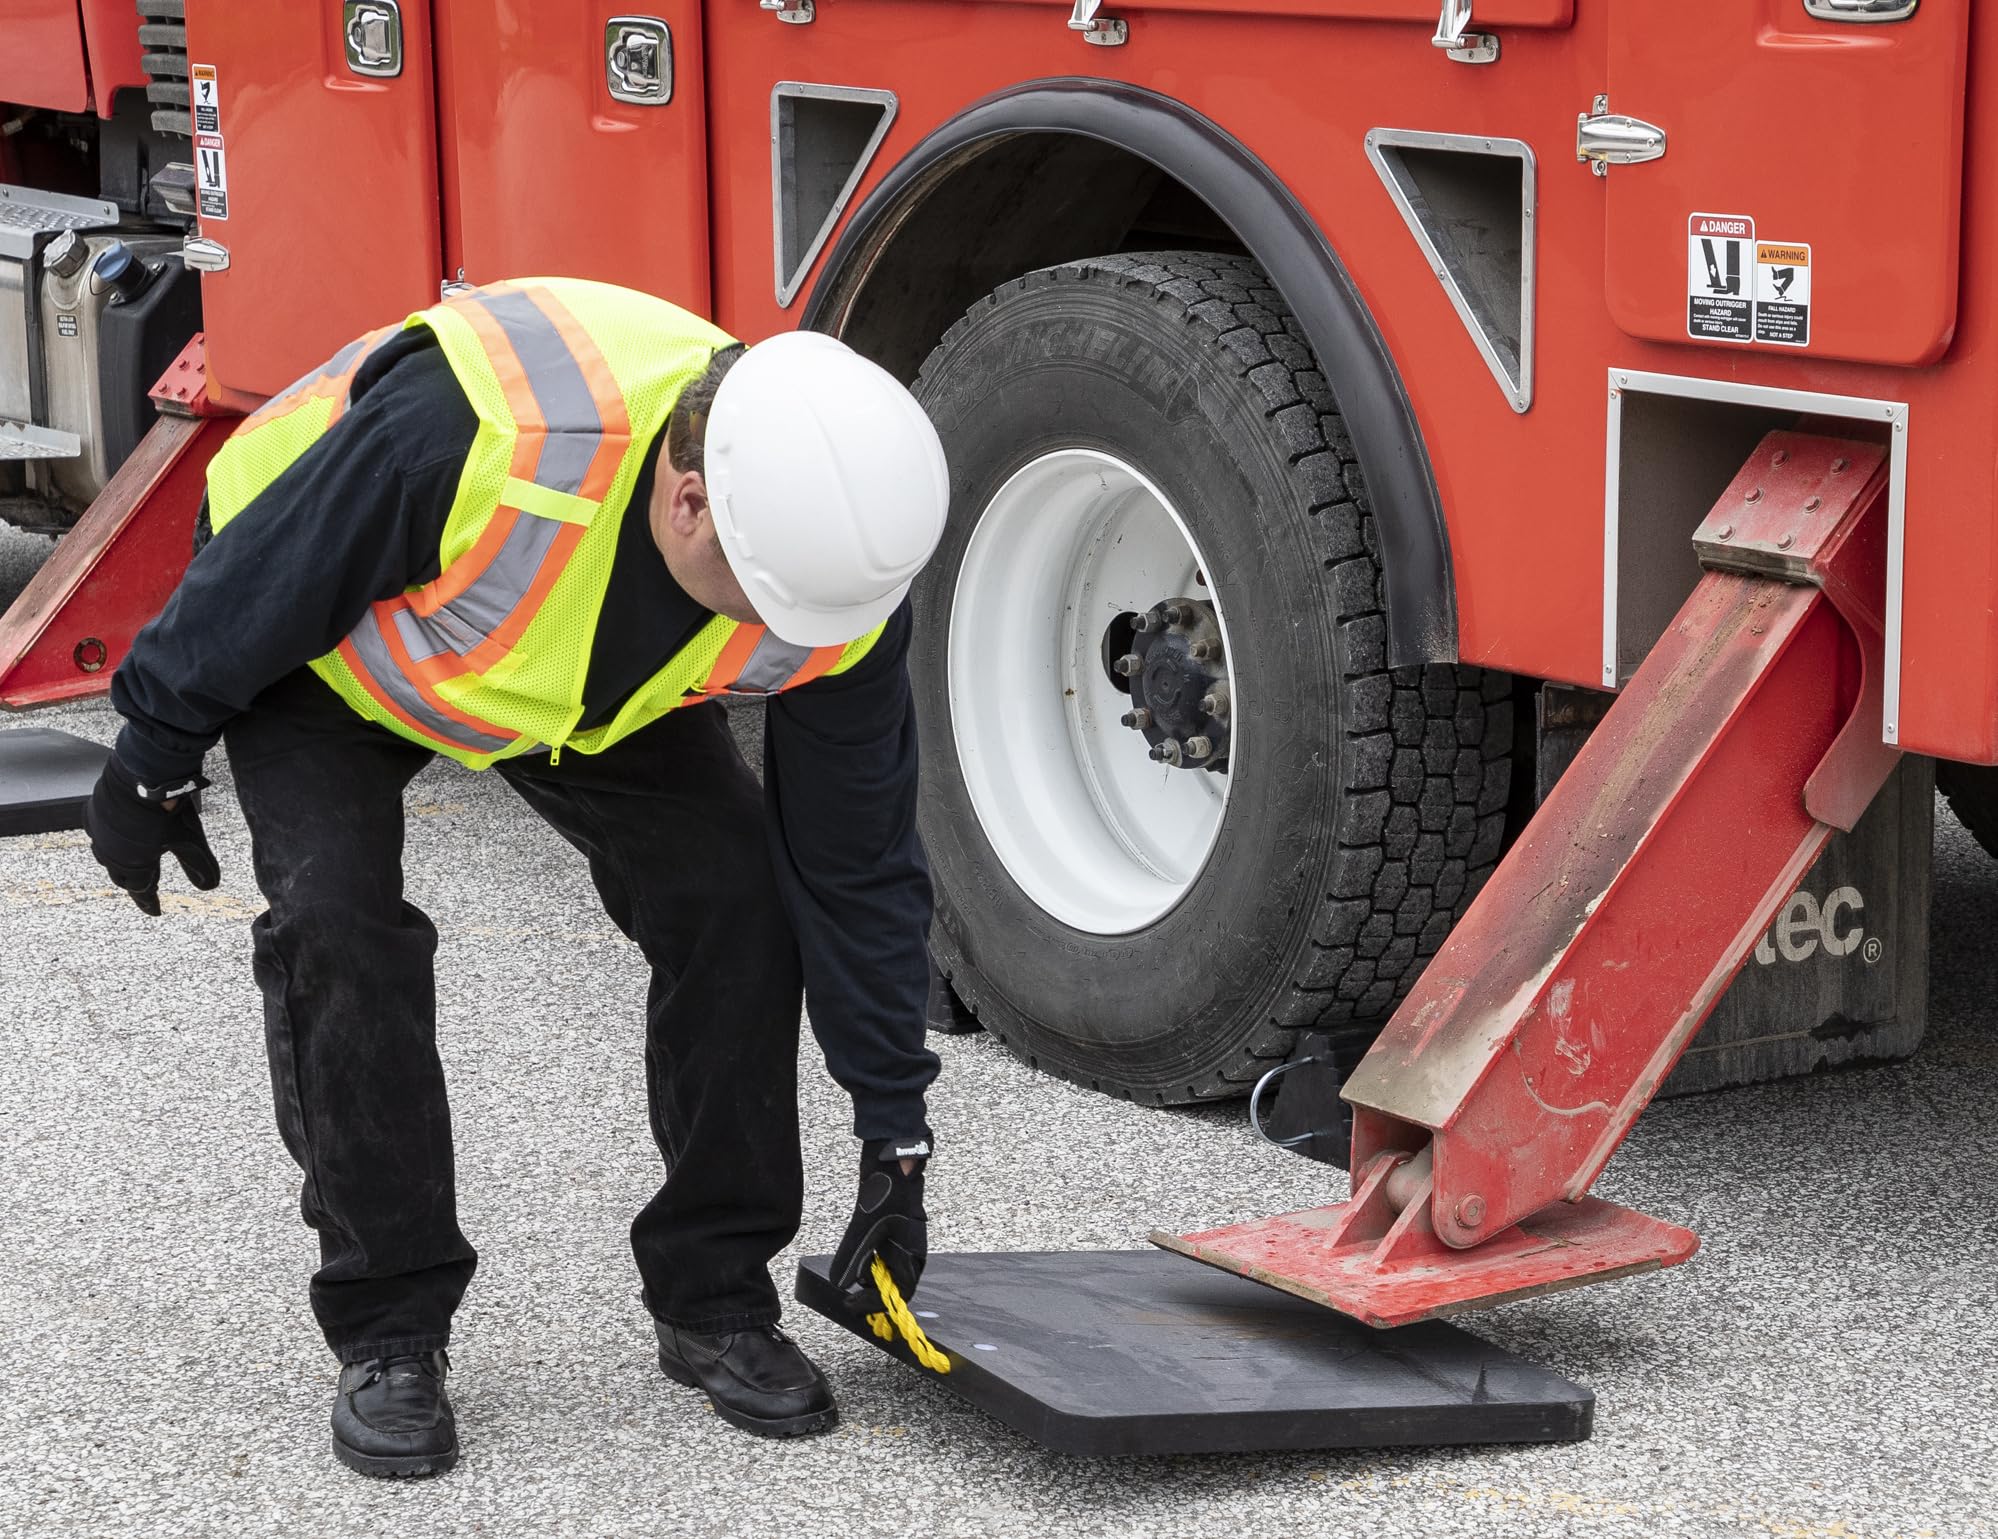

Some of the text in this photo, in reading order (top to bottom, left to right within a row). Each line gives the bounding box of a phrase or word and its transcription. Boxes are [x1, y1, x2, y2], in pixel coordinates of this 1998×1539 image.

[1709, 220, 1746, 235] DANGER
[1768, 249, 1806, 261] WARNING
[1694, 298, 1746, 308] MOVING OUTRIGGER
[1709, 308, 1732, 316] HAZARD
